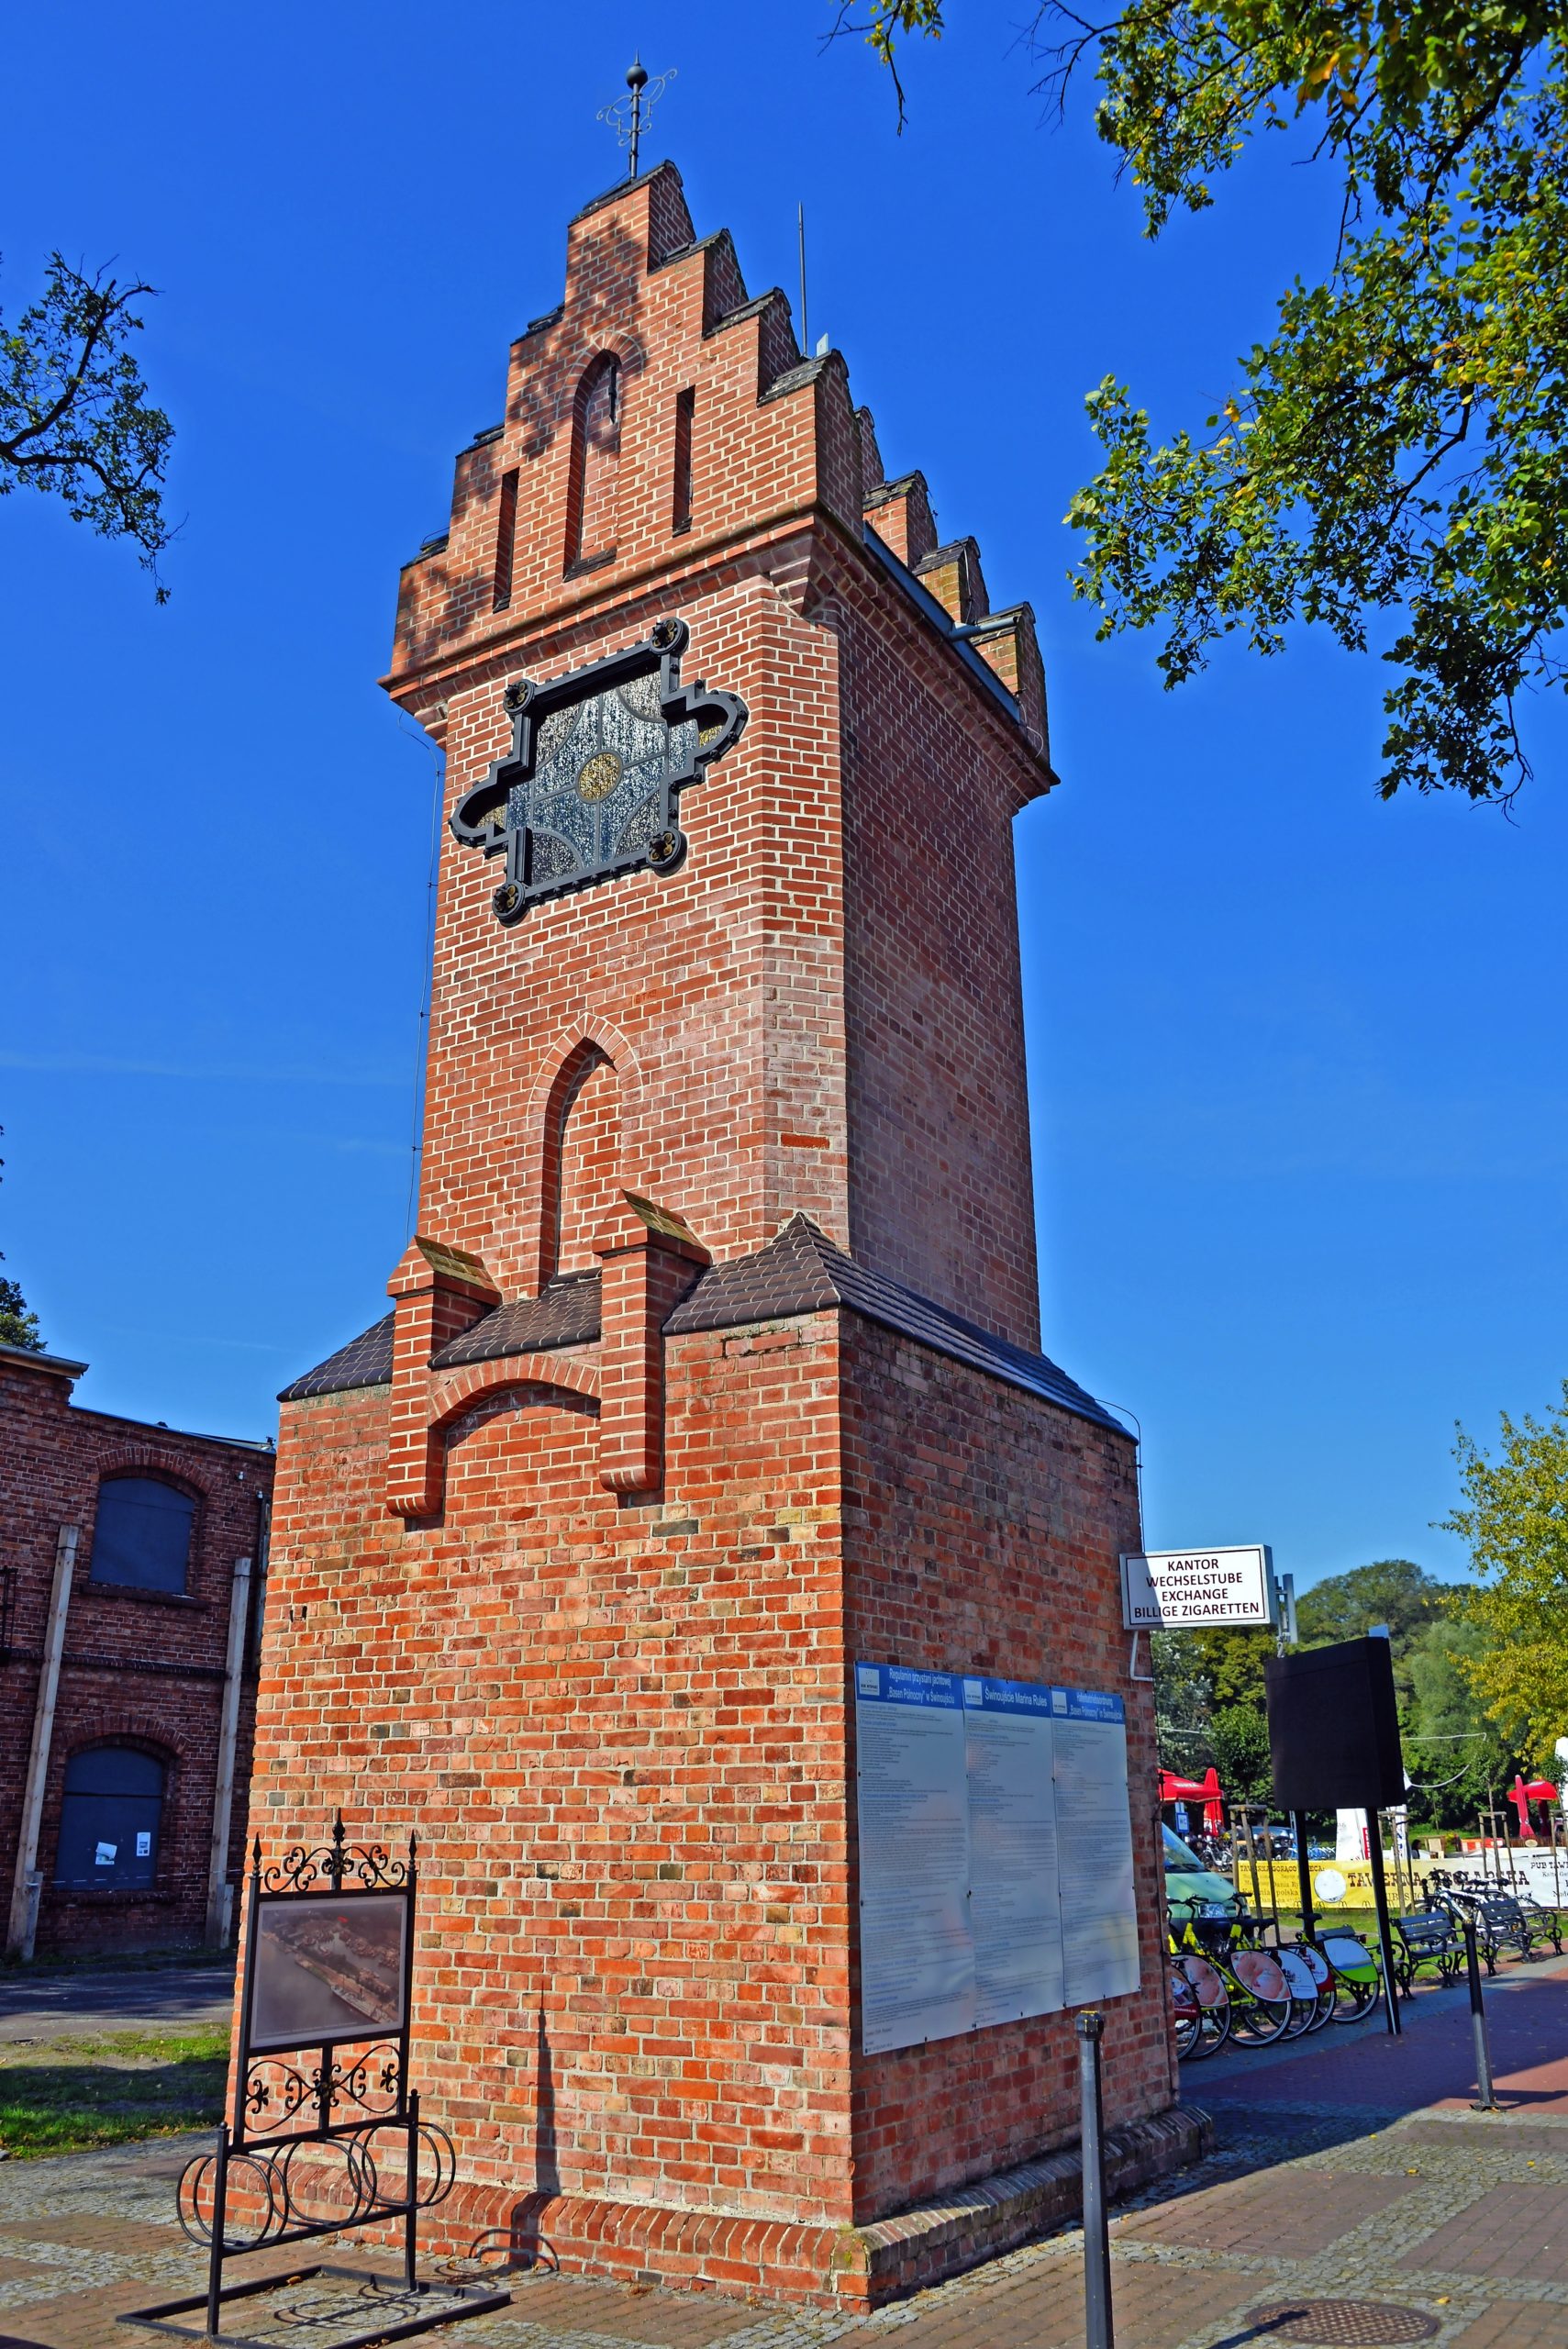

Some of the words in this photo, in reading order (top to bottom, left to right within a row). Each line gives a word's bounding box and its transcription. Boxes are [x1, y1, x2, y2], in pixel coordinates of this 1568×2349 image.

[1168, 1559, 1218, 1572] KANTOR
[1146, 1573, 1242, 1587] WECHSELSTUBE
[1162, 1588, 1229, 1602] EXCHANGE
[1134, 1606, 1178, 1618] BILLIGE
[1182, 1602, 1259, 1616] ZIGARETTEN
[1015, 1692, 1032, 1706] Marina
[1032, 1694, 1048, 1708] Rules
